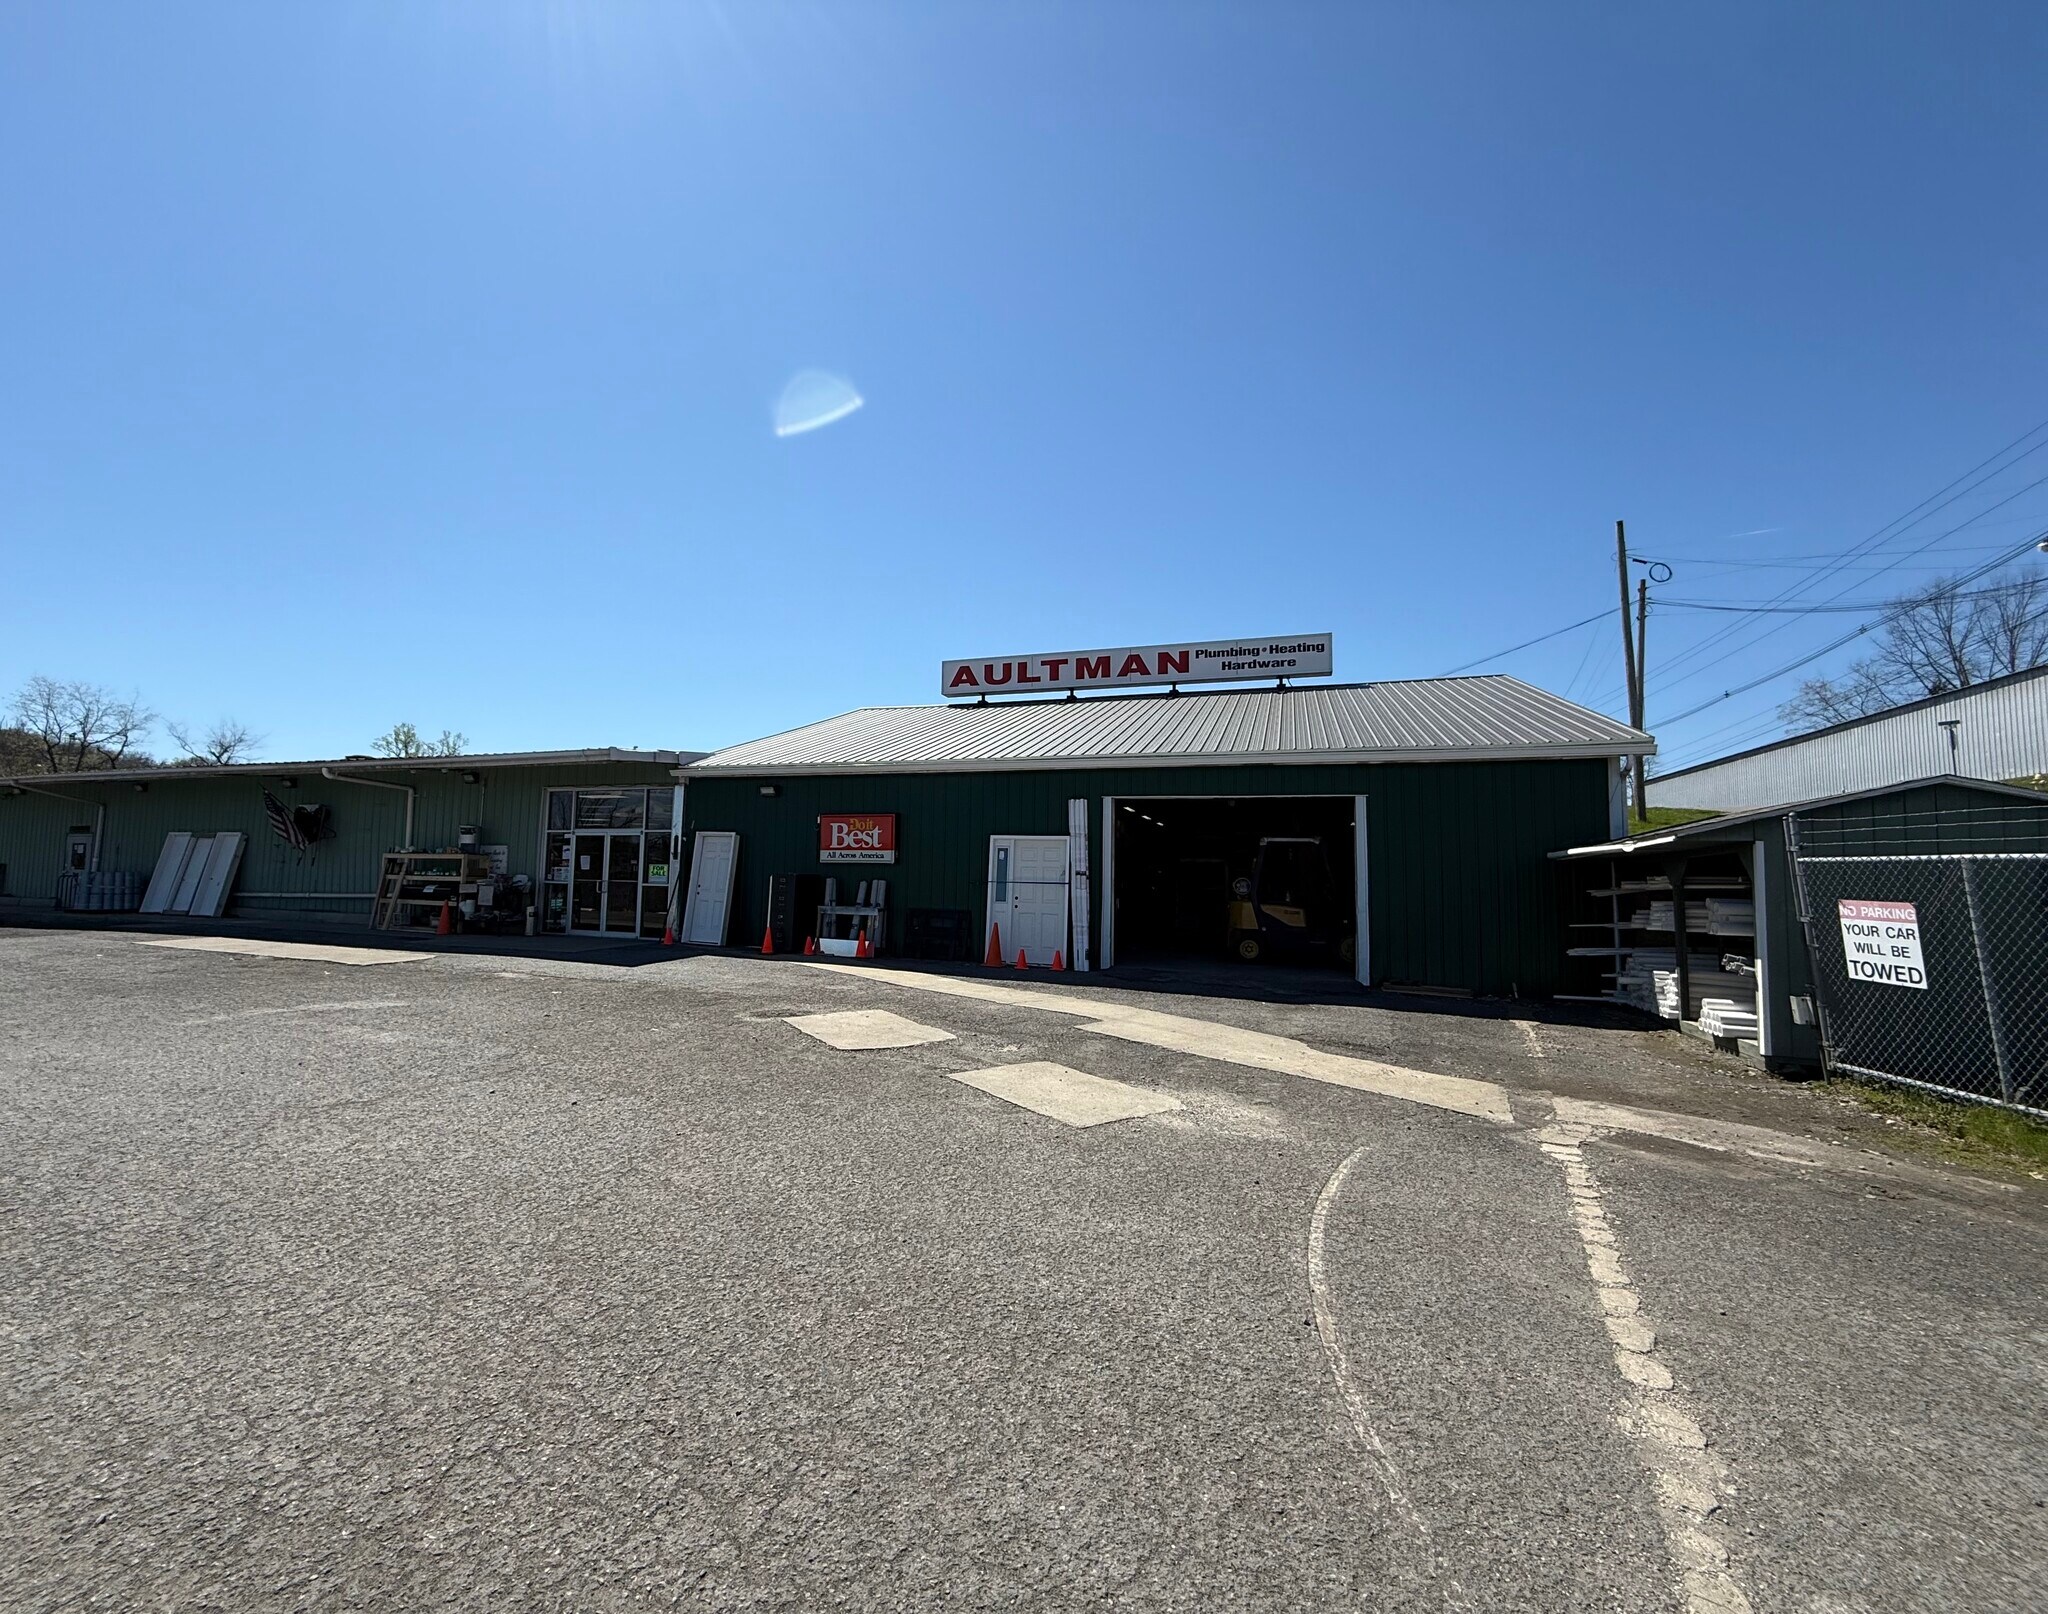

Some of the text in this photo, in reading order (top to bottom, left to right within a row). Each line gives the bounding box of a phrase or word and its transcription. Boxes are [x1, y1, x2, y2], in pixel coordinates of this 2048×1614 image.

[949, 650, 1190, 688] AULTMAN
[1221, 657, 1297, 671] Hardware
[829, 822, 883, 849] Best
[1839, 905, 1916, 920] NO PARKING
[1843, 923, 1916, 940] YOUR CAR
[1853, 942, 1911, 958] WILL BE
[1849, 960, 1923, 985] TOWED
